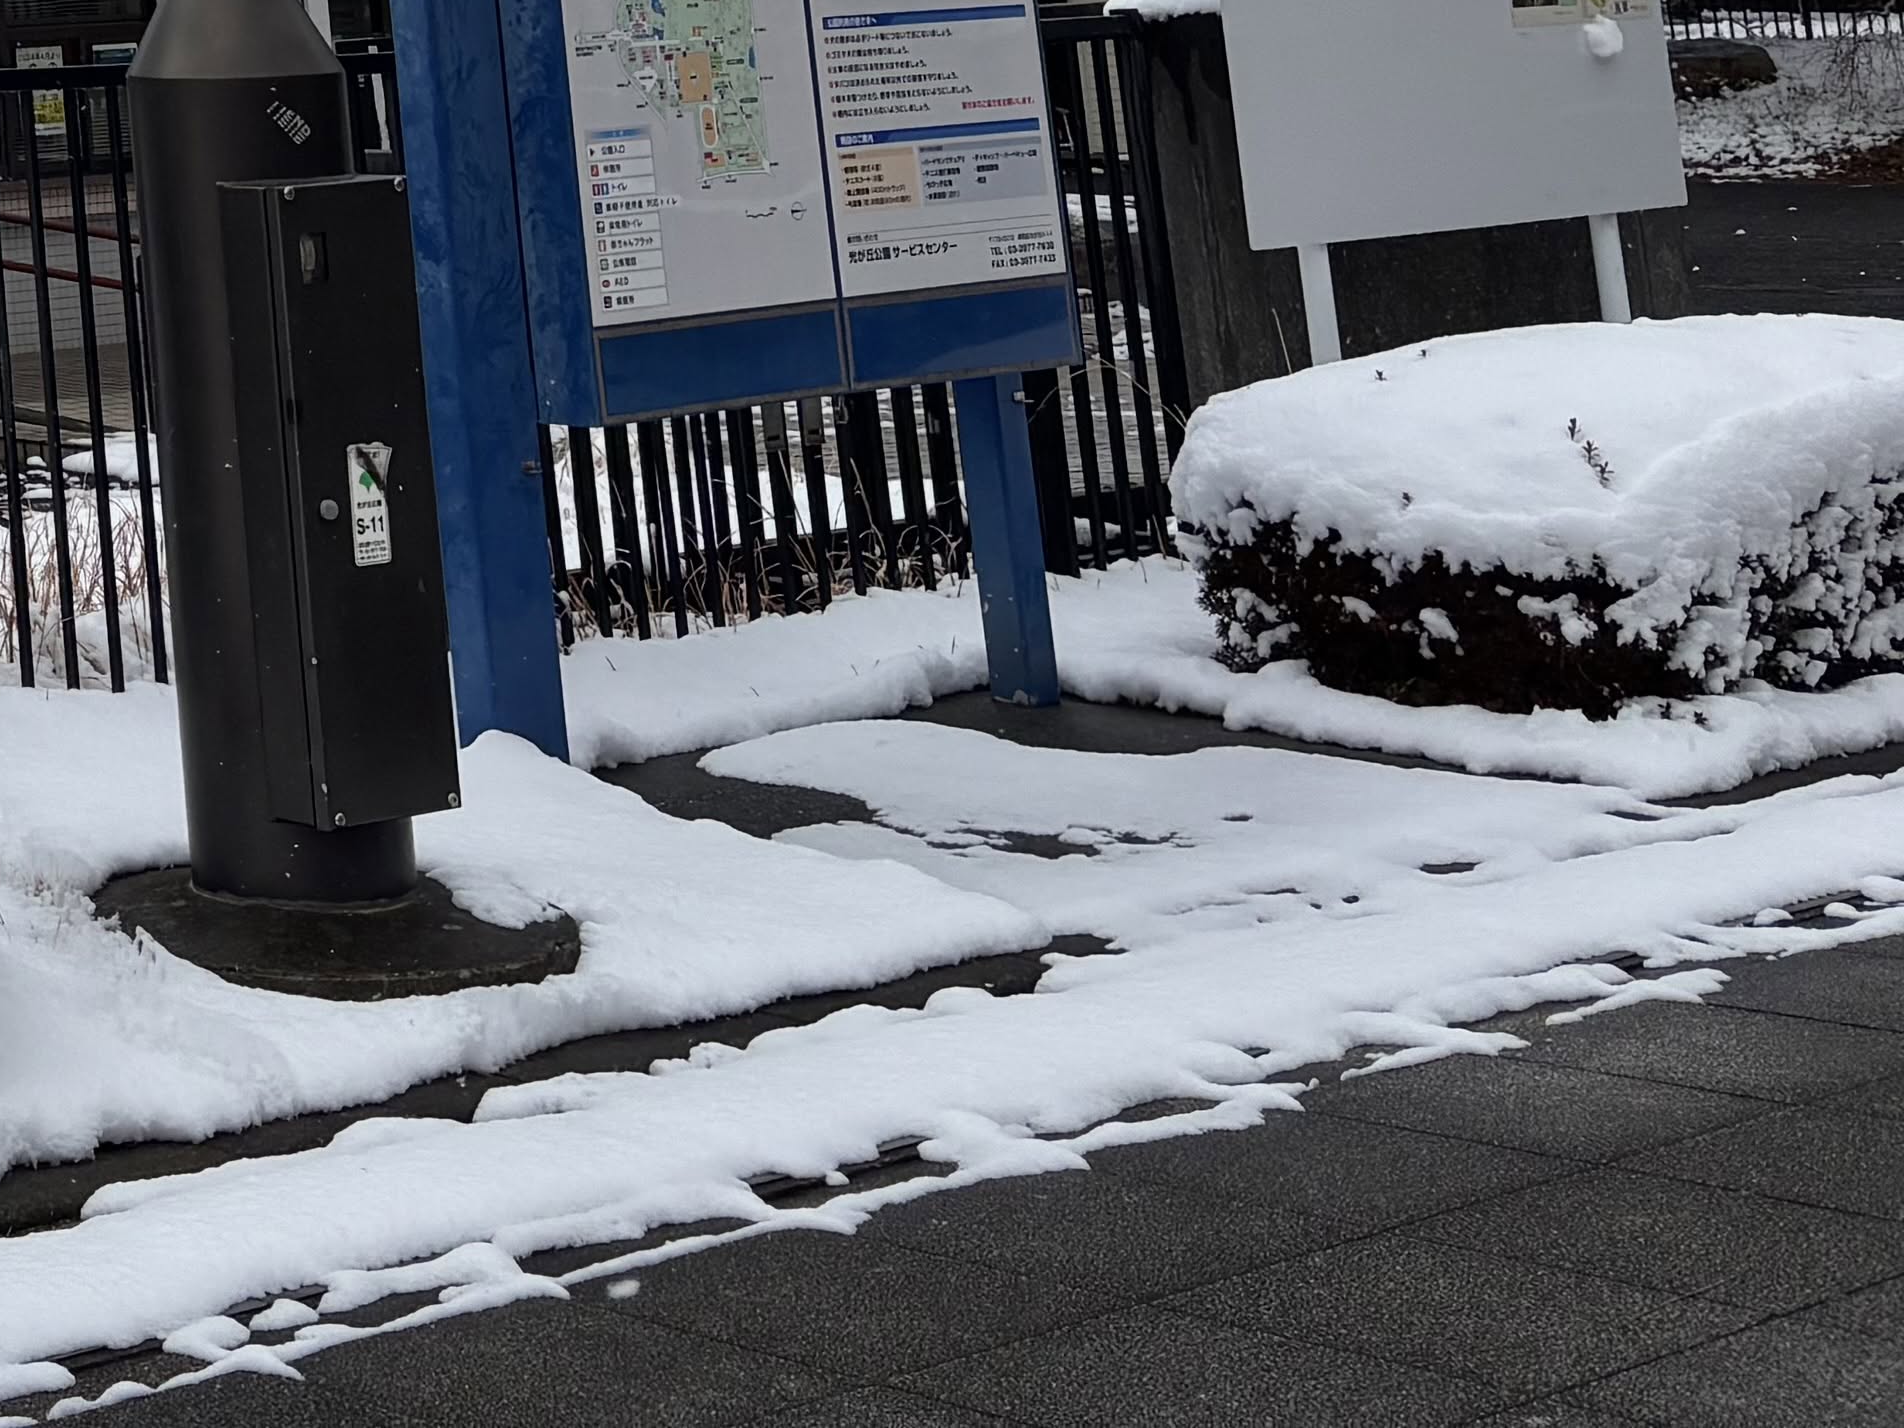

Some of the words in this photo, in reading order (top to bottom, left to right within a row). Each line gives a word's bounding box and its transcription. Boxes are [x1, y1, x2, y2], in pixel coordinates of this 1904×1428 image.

[611, 182, 628, 193] トイレ
[848, 246, 891, 264] 光が丘公園
[892, 243, 958, 261] サービスセンター
[614, 276, 629, 287] AED
[356, 515, 384, 535] S-11
